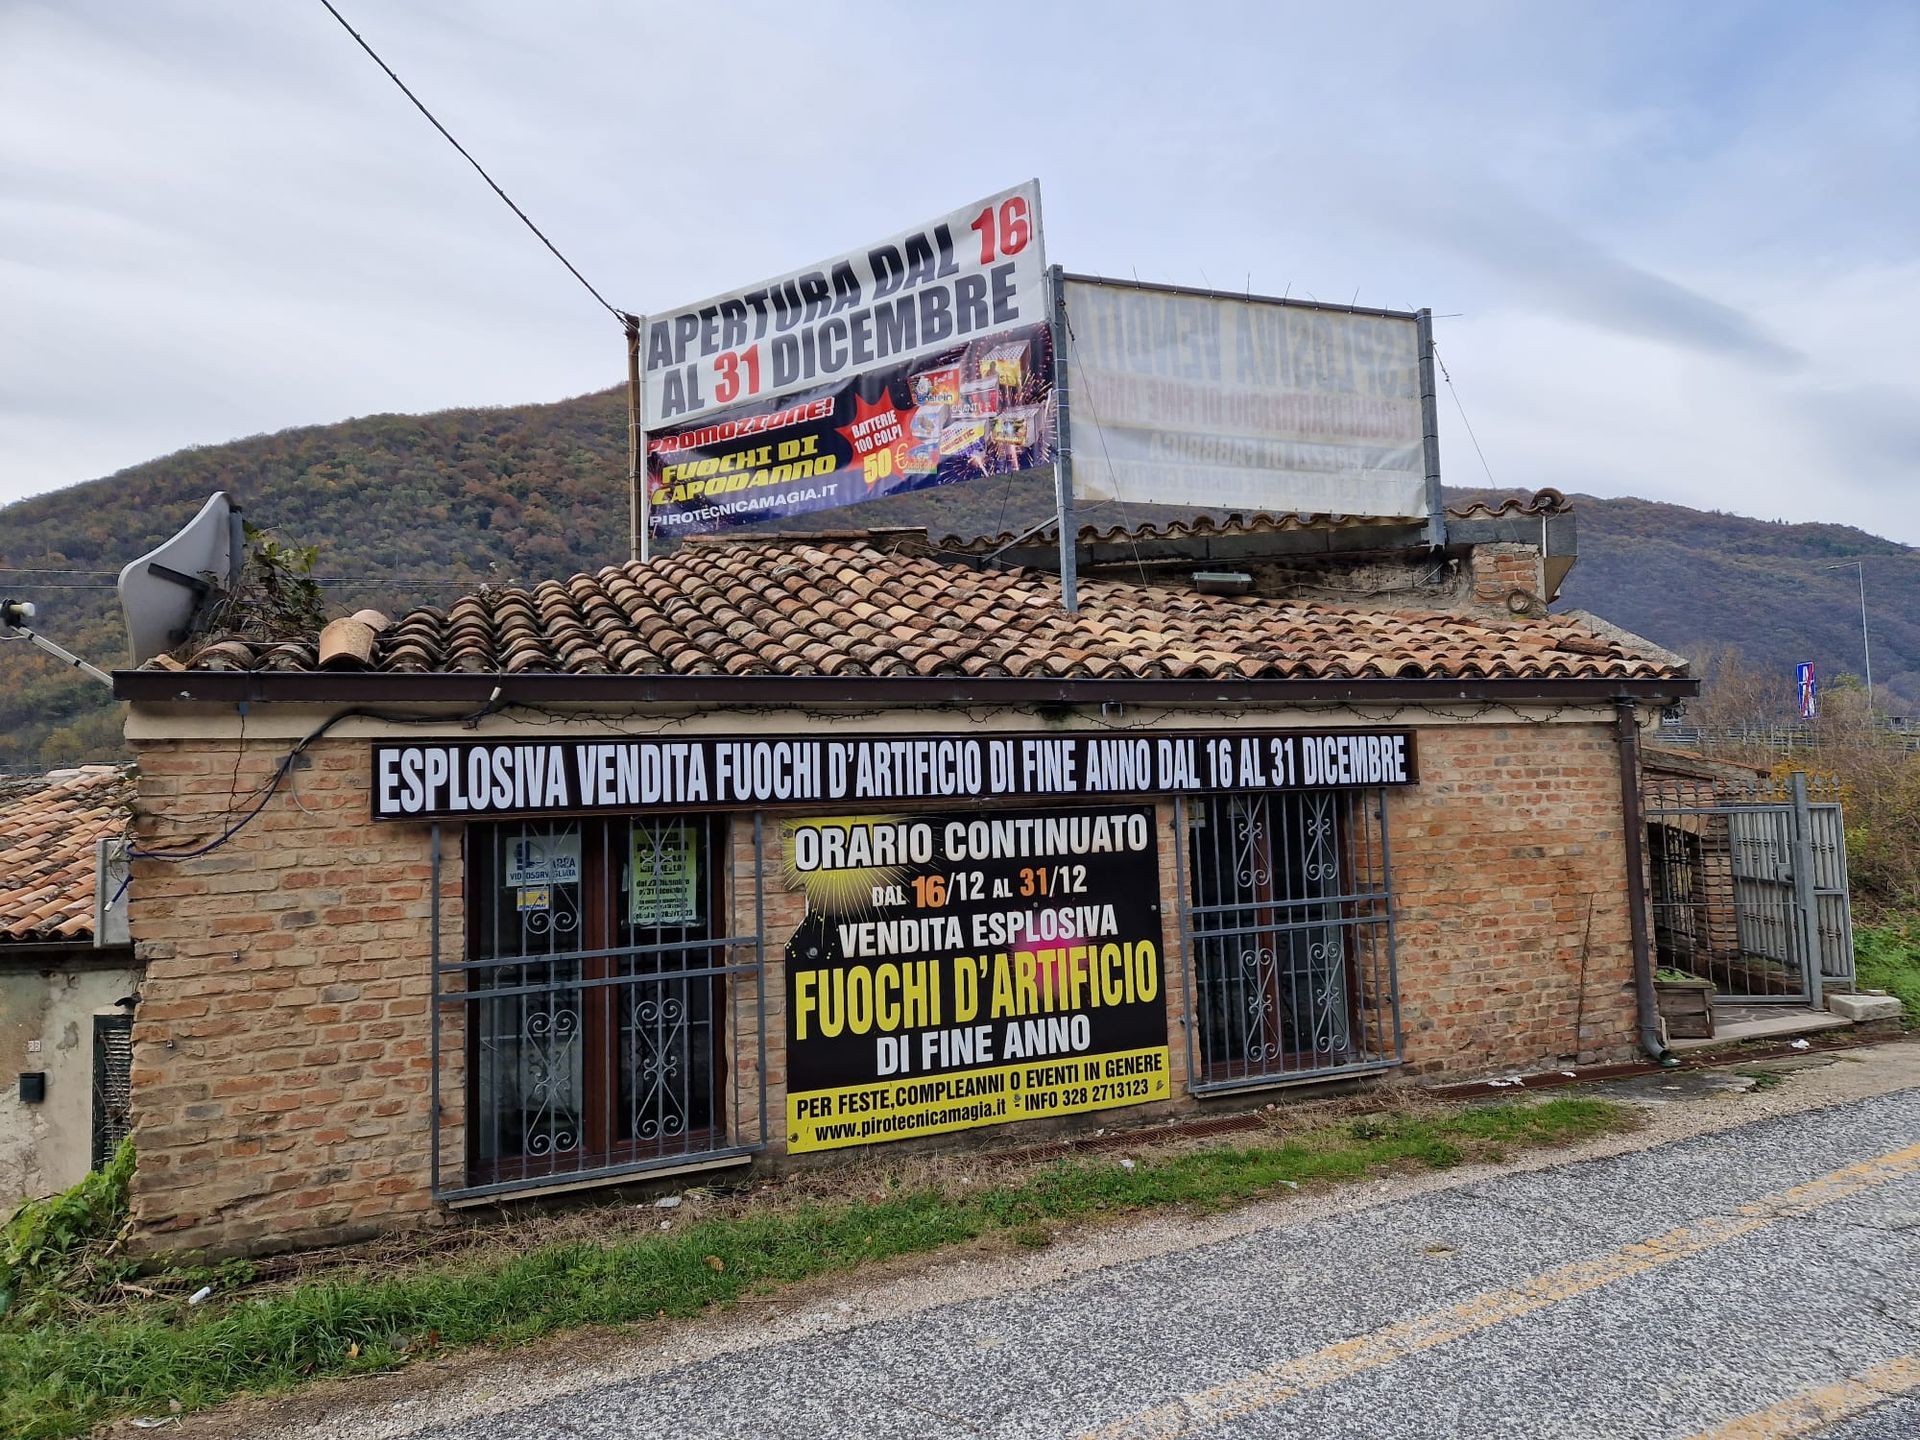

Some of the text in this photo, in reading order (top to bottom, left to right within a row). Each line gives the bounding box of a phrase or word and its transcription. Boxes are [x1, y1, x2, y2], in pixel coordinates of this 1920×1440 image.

[647, 196, 1029, 372] APERTURA DAL 16
[661, 262, 1020, 419] AL 31 DICEMBRE
[851, 409, 897, 439] BATTERIE
[854, 424, 903, 454] 100 COLPI
[651, 454, 836, 505] CAPODANNO
[662, 434, 819, 484] FUOCHI DI
[863, 442, 908, 484] 50 €
[650, 483, 838, 527] PIROTECNICAMAGIA.IT
[379, 735, 1407, 813] ESPLOSIVA VENDITA FUOCHI D'ARTIFICIO DI FINE ANNO DAL 16 AL 31 DICEMBRE
[795, 814, 1148, 871] ORARIO CONTINUATO
[872, 865, 1088, 908] DAL 16/12 AL 31/12
[839, 904, 1118, 958] VENDITA ESPLOSIVA
[795, 940, 1158, 1040] FUOCHI D'ARTIFICIO
[876, 1015, 1091, 1076] DI FINE ANNO
[797, 1097, 832, 1119] PER
[1010, 1071, 1021, 1091] O
[1026, 1065, 1079, 1089] EVENTI
[1084, 1061, 1100, 1080] IN
[1105, 1053, 1163, 1077] GENERE
[815, 1102, 1007, 1142] www.pirotecnicamagia.it
[1025, 1090, 1058, 1112] INFO
[1062, 1086, 1088, 1107] 328
[1092, 1079, 1149, 1103] 2713123
